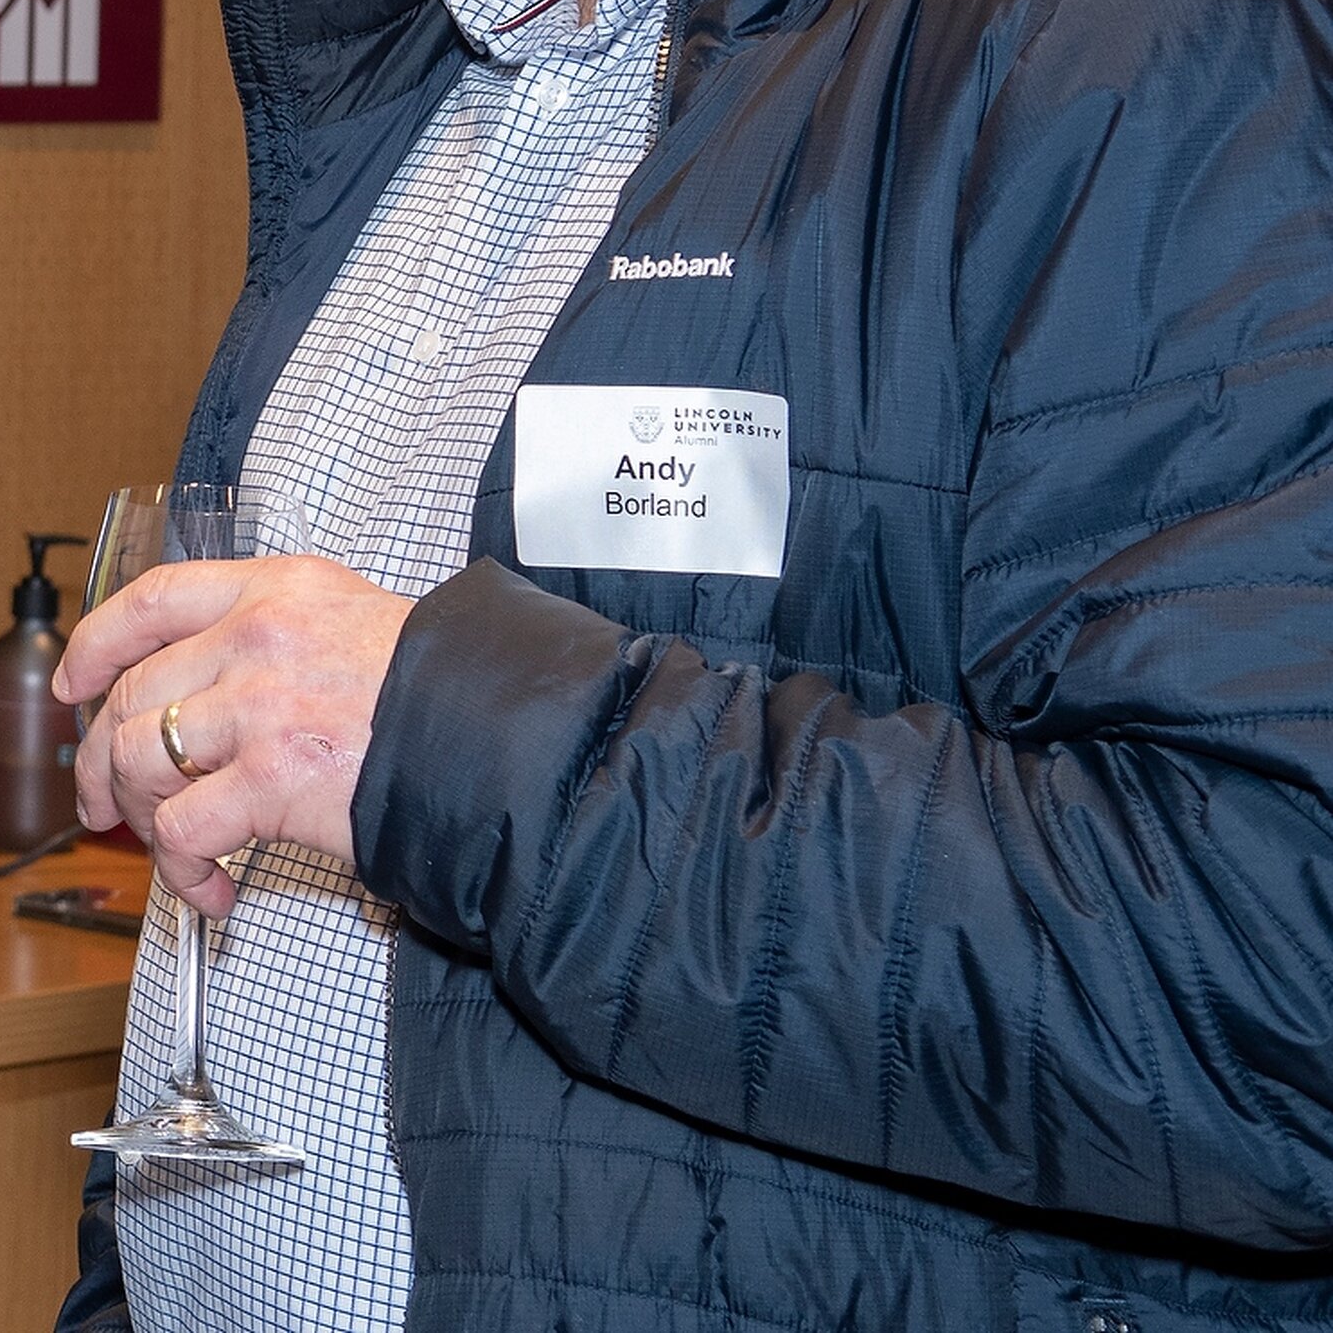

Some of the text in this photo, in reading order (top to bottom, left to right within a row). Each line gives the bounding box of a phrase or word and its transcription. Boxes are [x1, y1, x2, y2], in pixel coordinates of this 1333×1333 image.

[608, 252, 735, 281] Rabobank
[674, 407, 753, 422] LINCOLN
[674, 421, 782, 440] UNIVERSITY
[674, 435, 719, 447] Alumni
[614, 454, 696, 488] Andy
[604, 491, 708, 518] Borland
